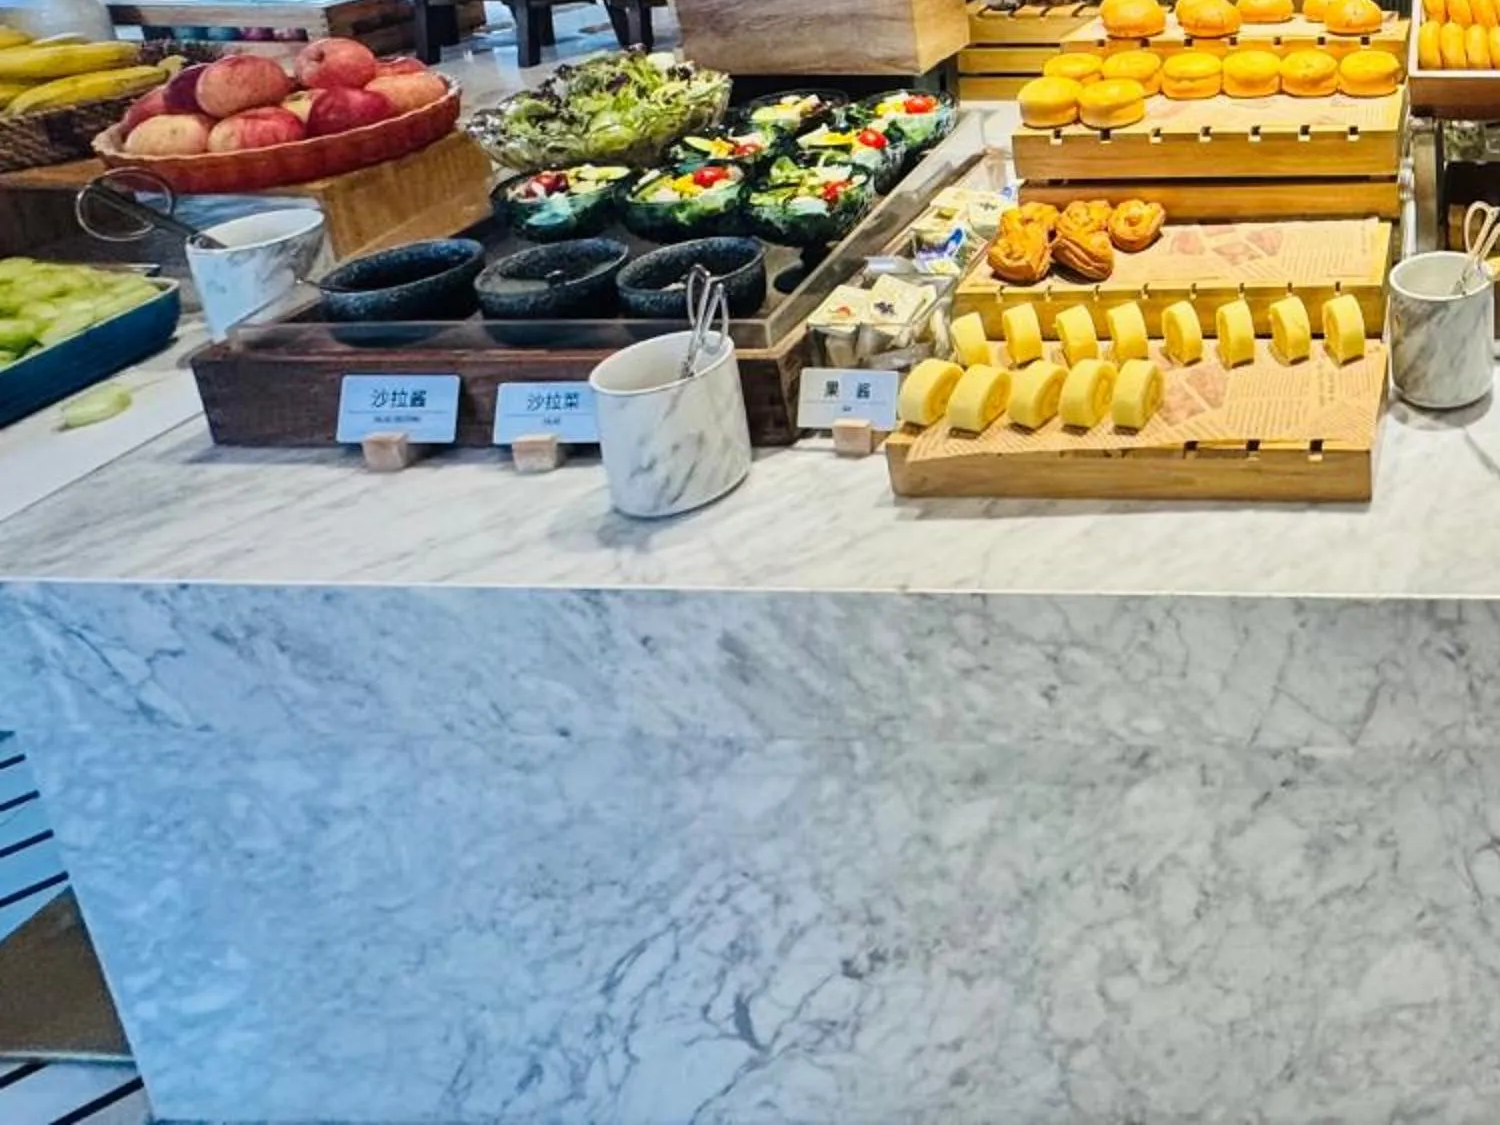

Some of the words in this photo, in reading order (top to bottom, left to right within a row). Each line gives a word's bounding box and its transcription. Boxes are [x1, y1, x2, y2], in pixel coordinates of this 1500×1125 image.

[370, 388, 427, 408] 沙拉酱
[527, 392, 579, 412] 沙拉菜
